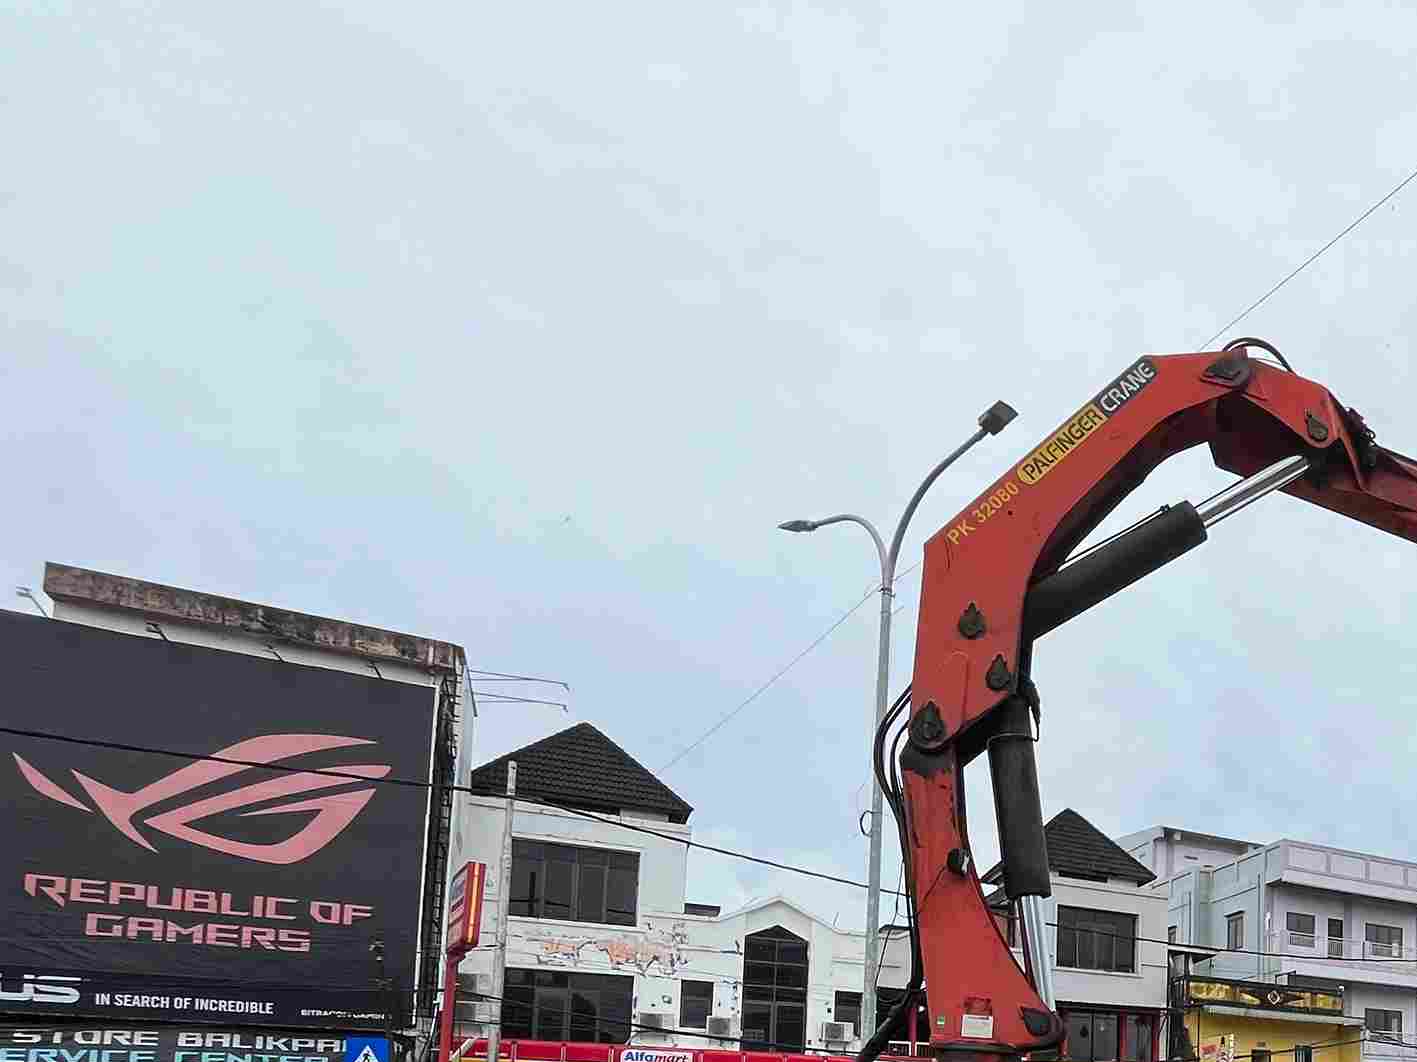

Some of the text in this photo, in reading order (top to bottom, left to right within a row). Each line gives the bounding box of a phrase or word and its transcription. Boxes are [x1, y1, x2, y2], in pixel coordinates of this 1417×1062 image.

[947, 362, 1156, 545] PK 32080 PALFINGER CRANE
[24, 873, 375, 925] REPUBLIC OF
[85, 912, 311, 952] GAMERS
[0, 974, 82, 1004] US
[95, 993, 275, 1015] IN SEARCH OF INCREDIBLE
[12, 1028, 346, 1053] STORE BALIKPA
